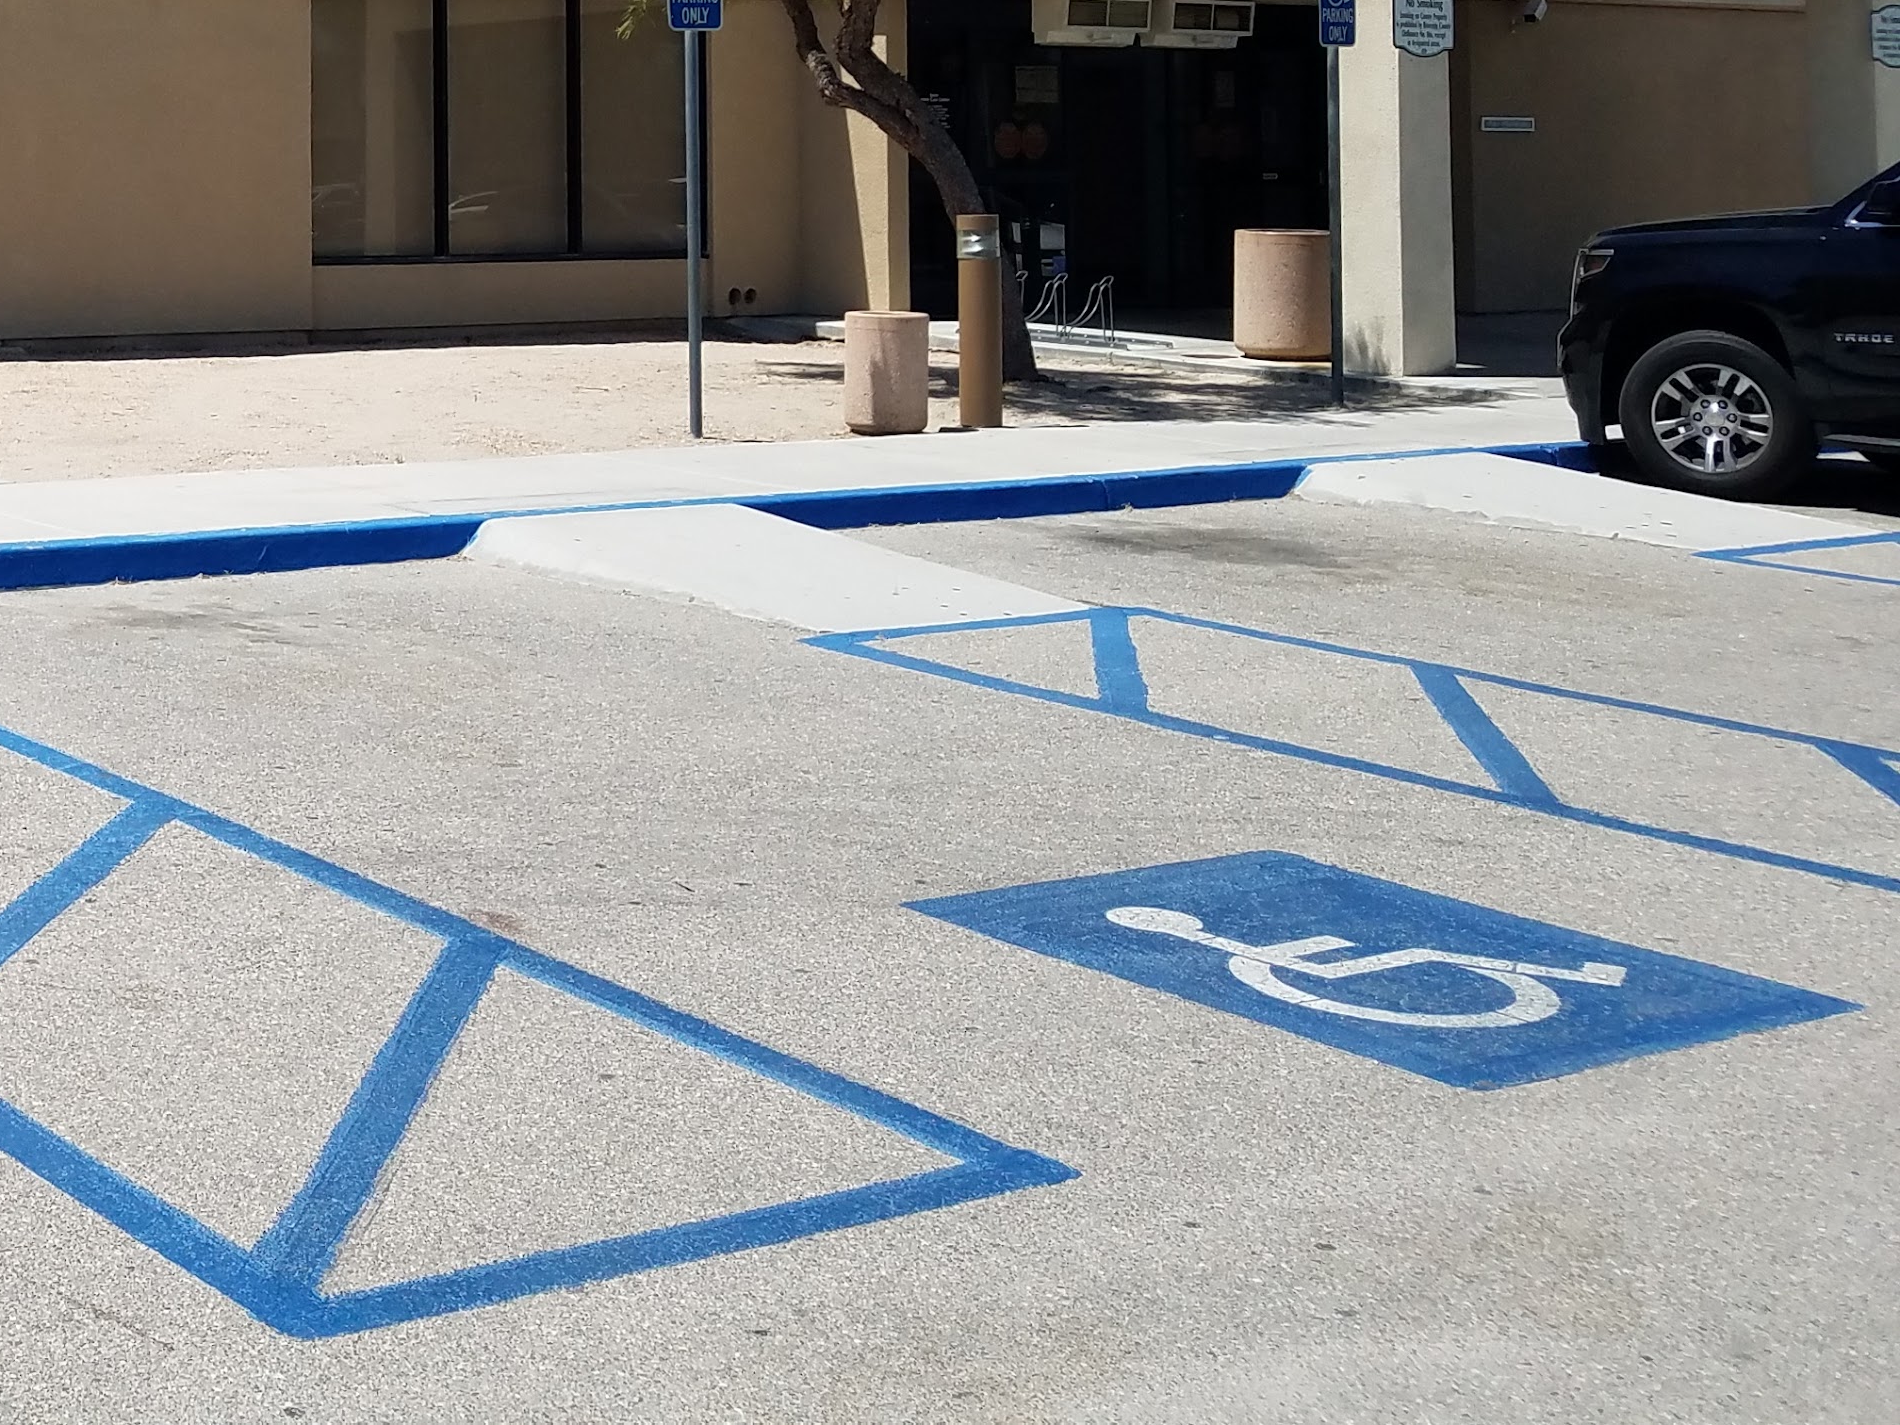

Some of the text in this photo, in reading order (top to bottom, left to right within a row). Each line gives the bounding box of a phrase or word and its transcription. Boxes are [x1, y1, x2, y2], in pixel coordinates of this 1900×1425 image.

[681, 7, 709, 25] ONLY
[1322, 8, 1354, 23] PARKING
[1329, 25, 1348, 42] ONLY
[1833, 332, 1894, 343] TAHOE
